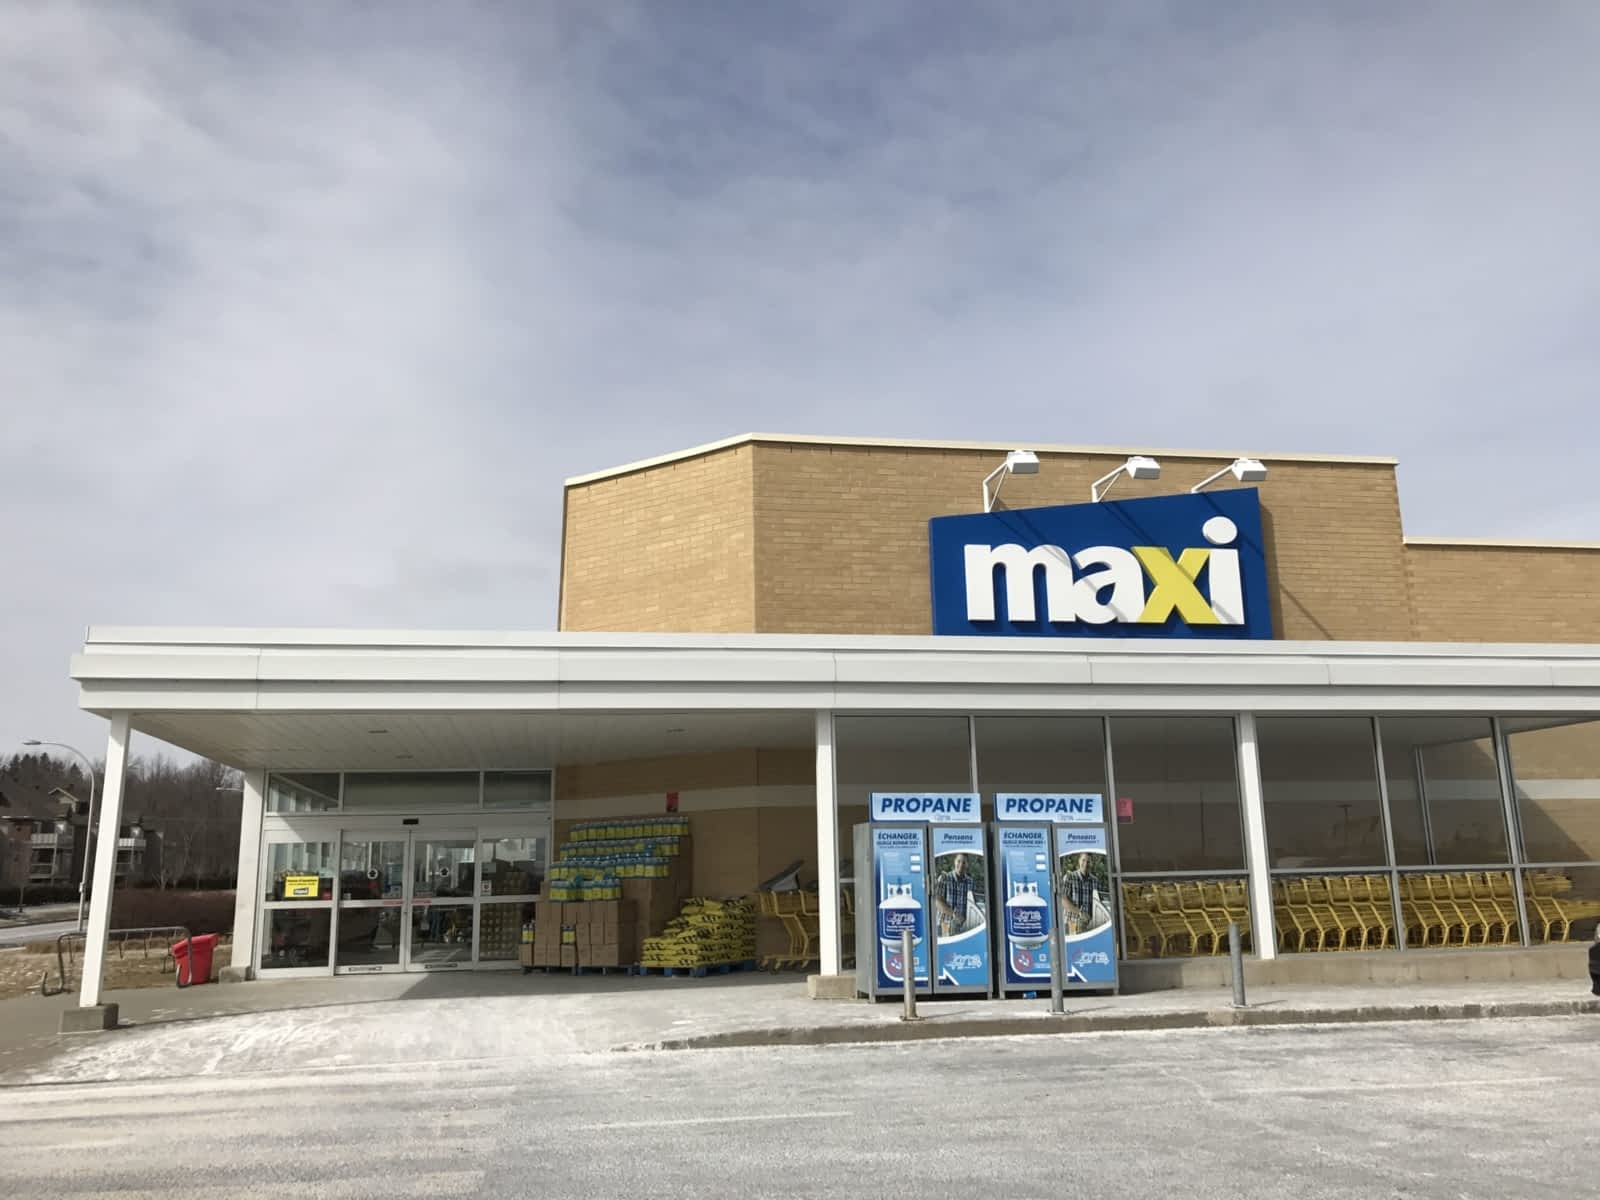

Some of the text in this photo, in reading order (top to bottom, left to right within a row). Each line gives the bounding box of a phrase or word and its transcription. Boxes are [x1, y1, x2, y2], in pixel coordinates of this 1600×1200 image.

[964, 516, 1245, 625] maxi
[881, 797, 972, 813] PROPANE
[1005, 798, 1094, 813] PROPANE
